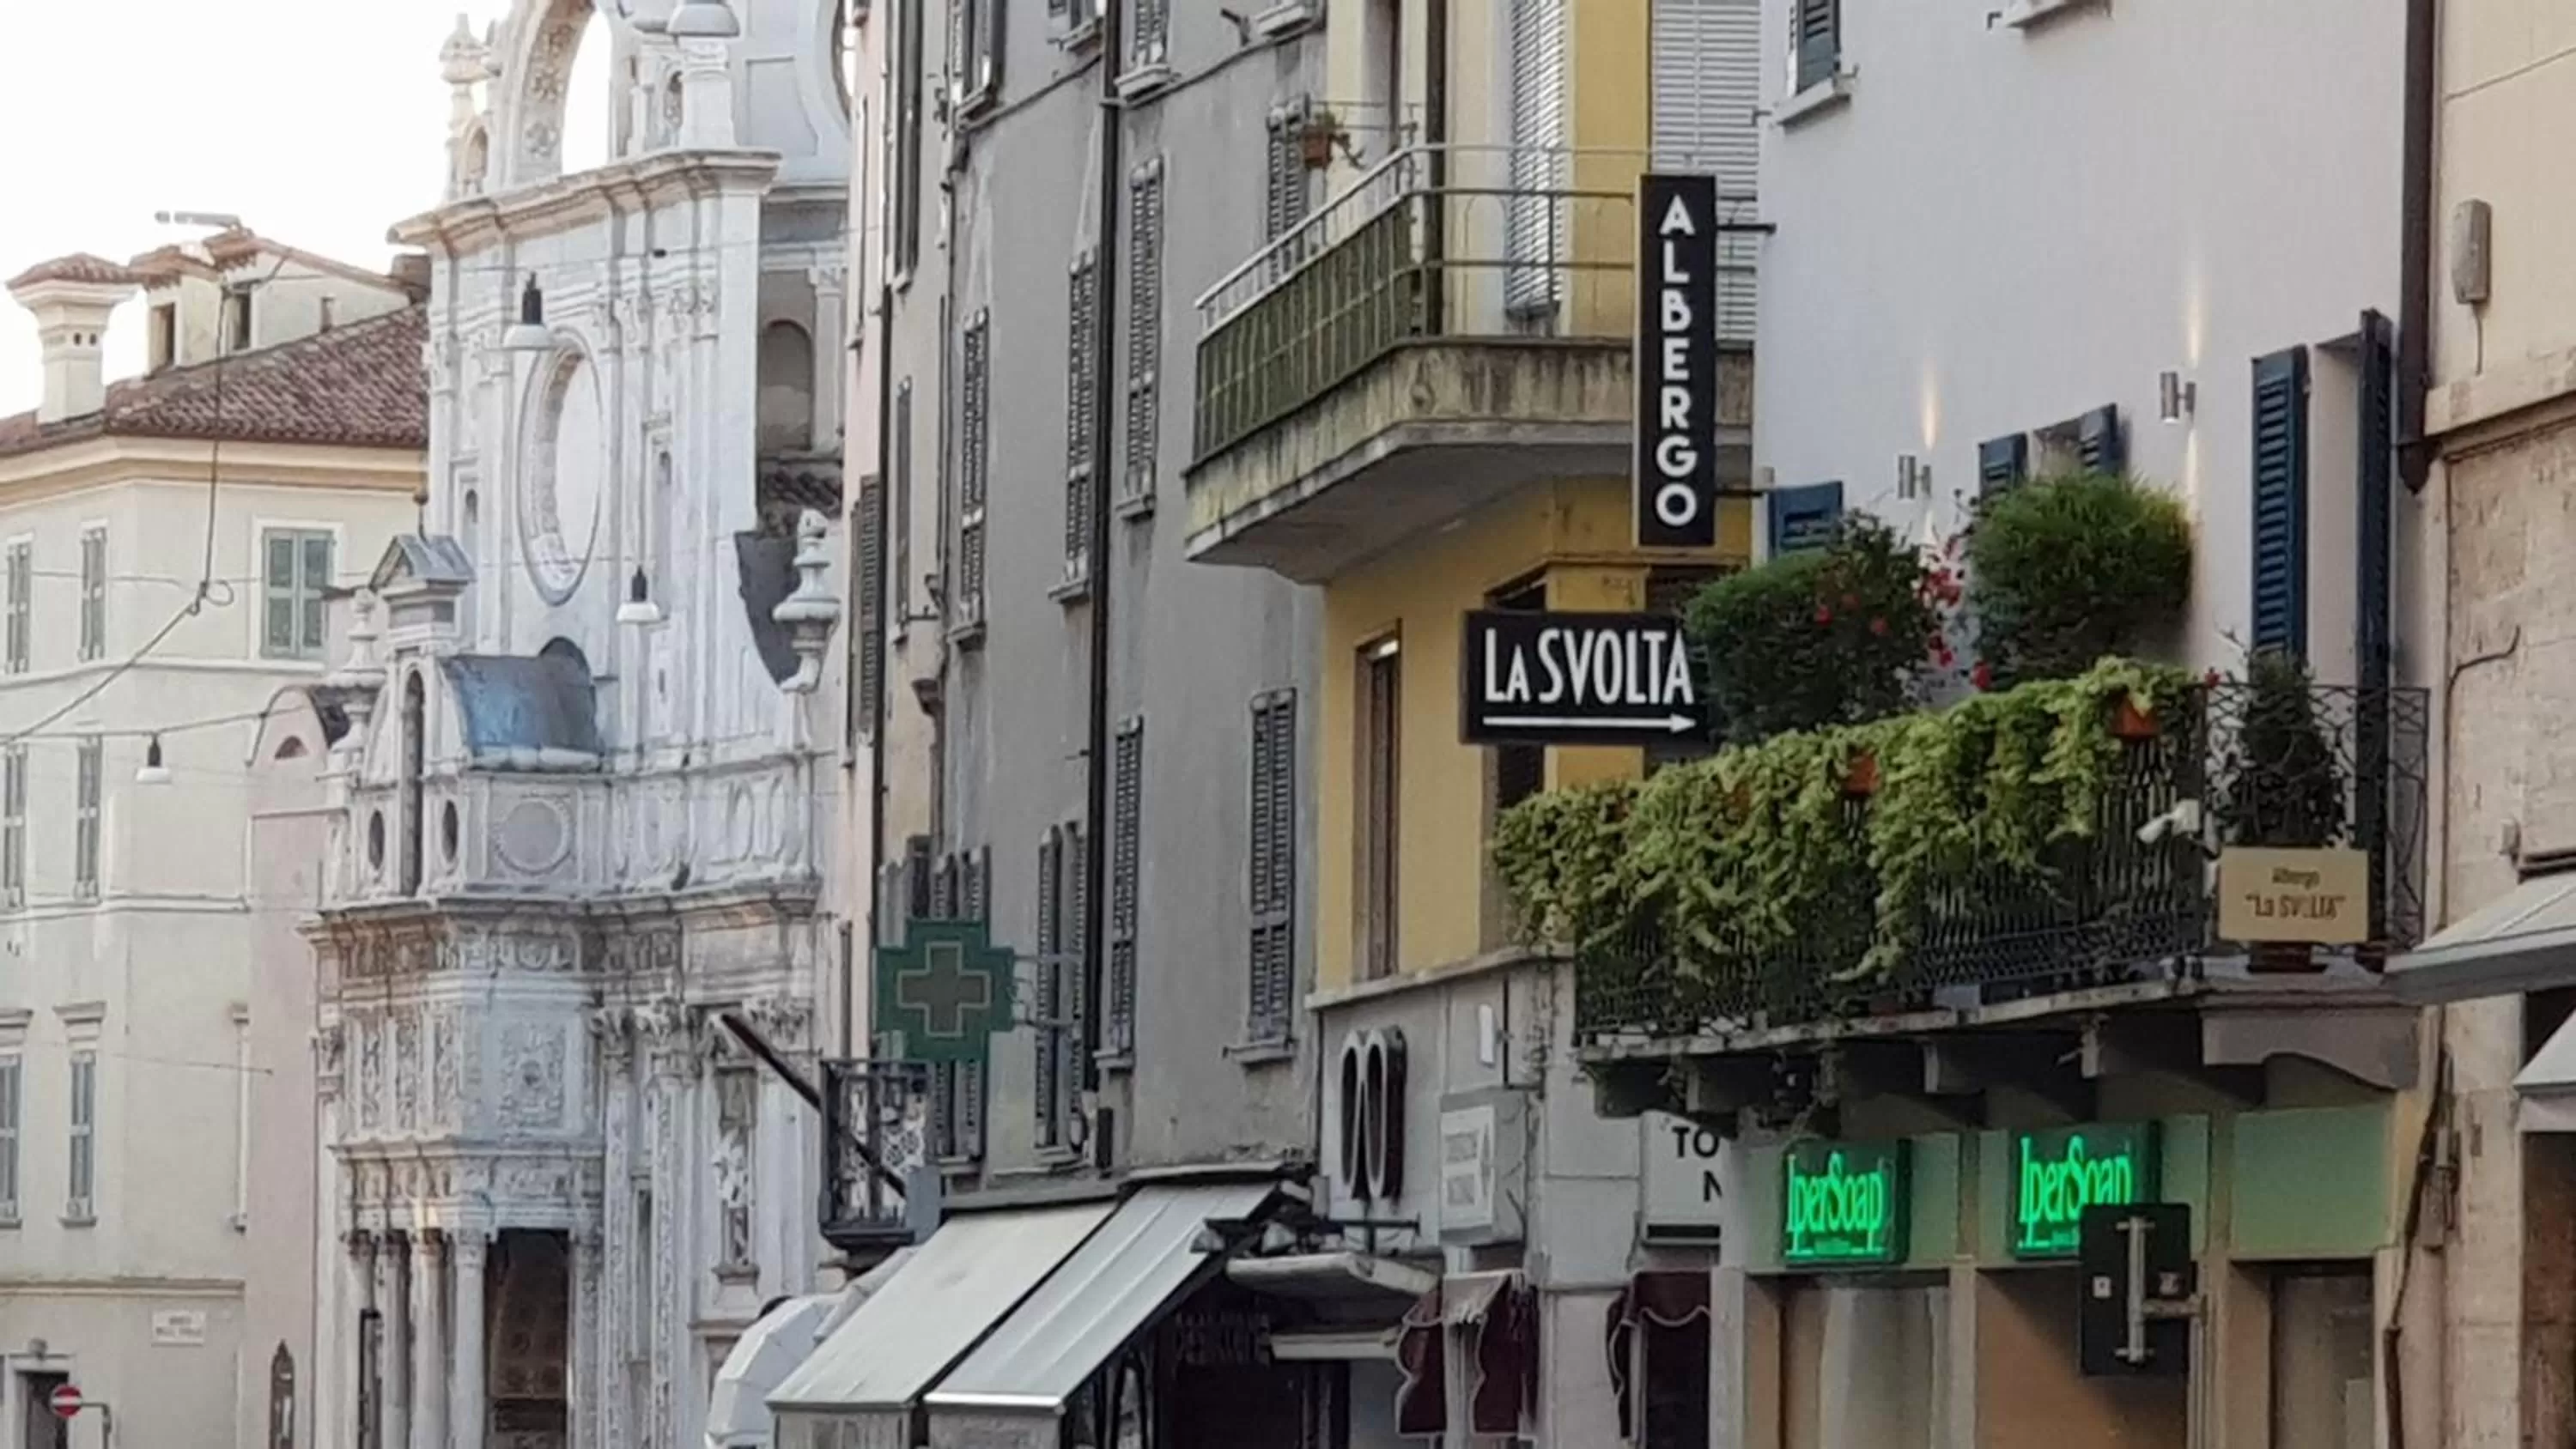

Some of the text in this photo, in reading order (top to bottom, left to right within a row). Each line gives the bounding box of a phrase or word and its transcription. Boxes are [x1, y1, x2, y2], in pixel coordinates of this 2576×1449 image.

[1655, 194, 1698, 526] ALBERGO
[1485, 627, 1694, 706] LA SVOLTA
[1786, 1151, 1884, 1255] IperSoap
